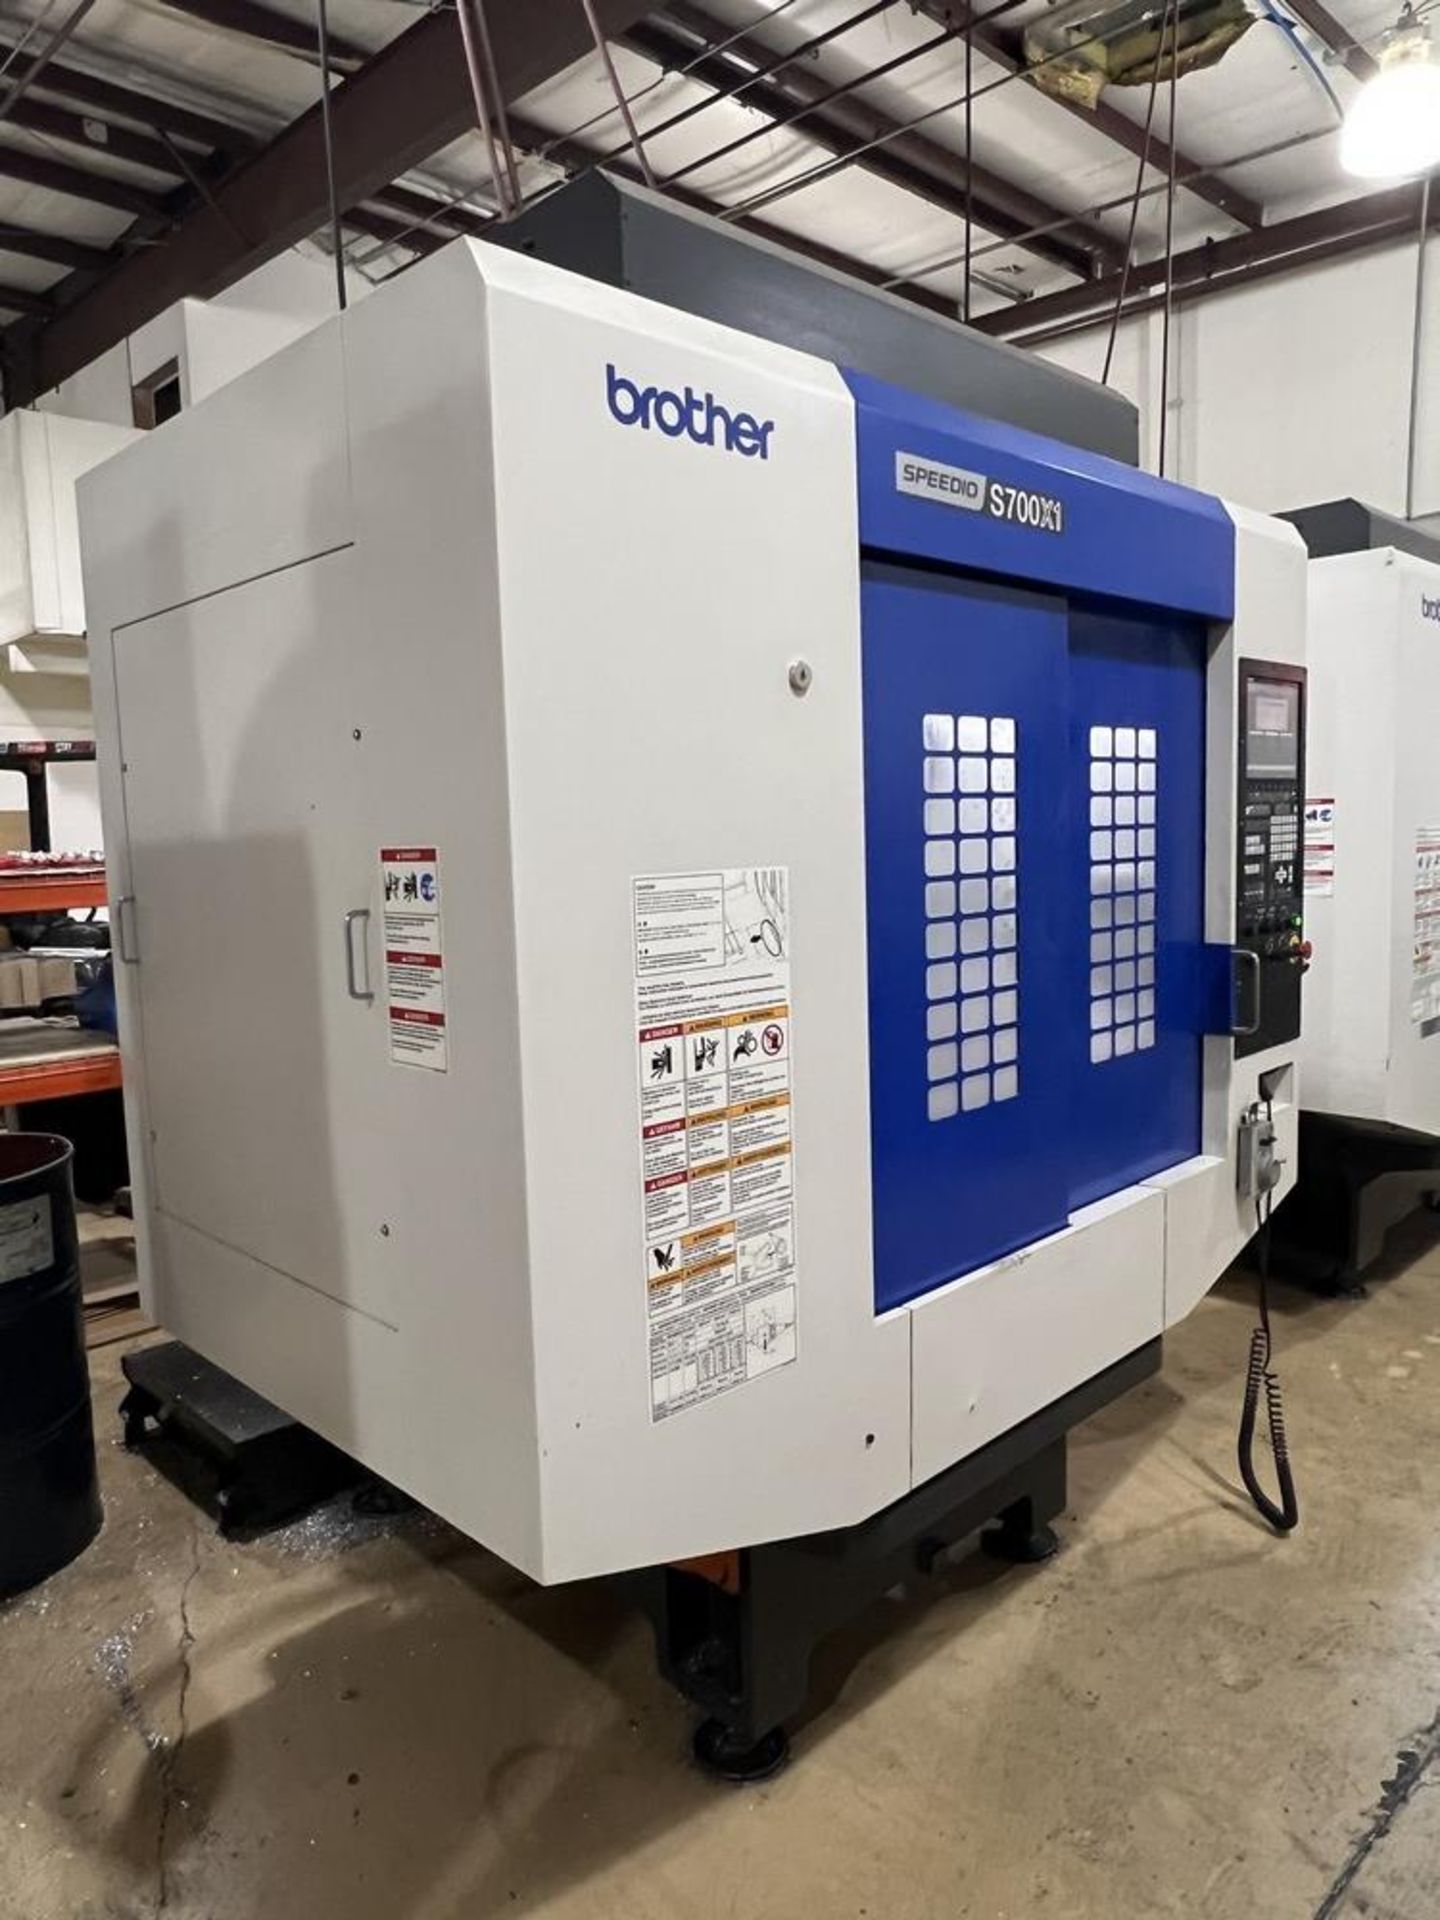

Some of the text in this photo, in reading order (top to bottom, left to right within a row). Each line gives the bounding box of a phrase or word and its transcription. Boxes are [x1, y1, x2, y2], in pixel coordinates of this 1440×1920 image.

[606, 363, 774, 459] brother
[903, 463, 1062, 532] SPEEDIO S700X1
